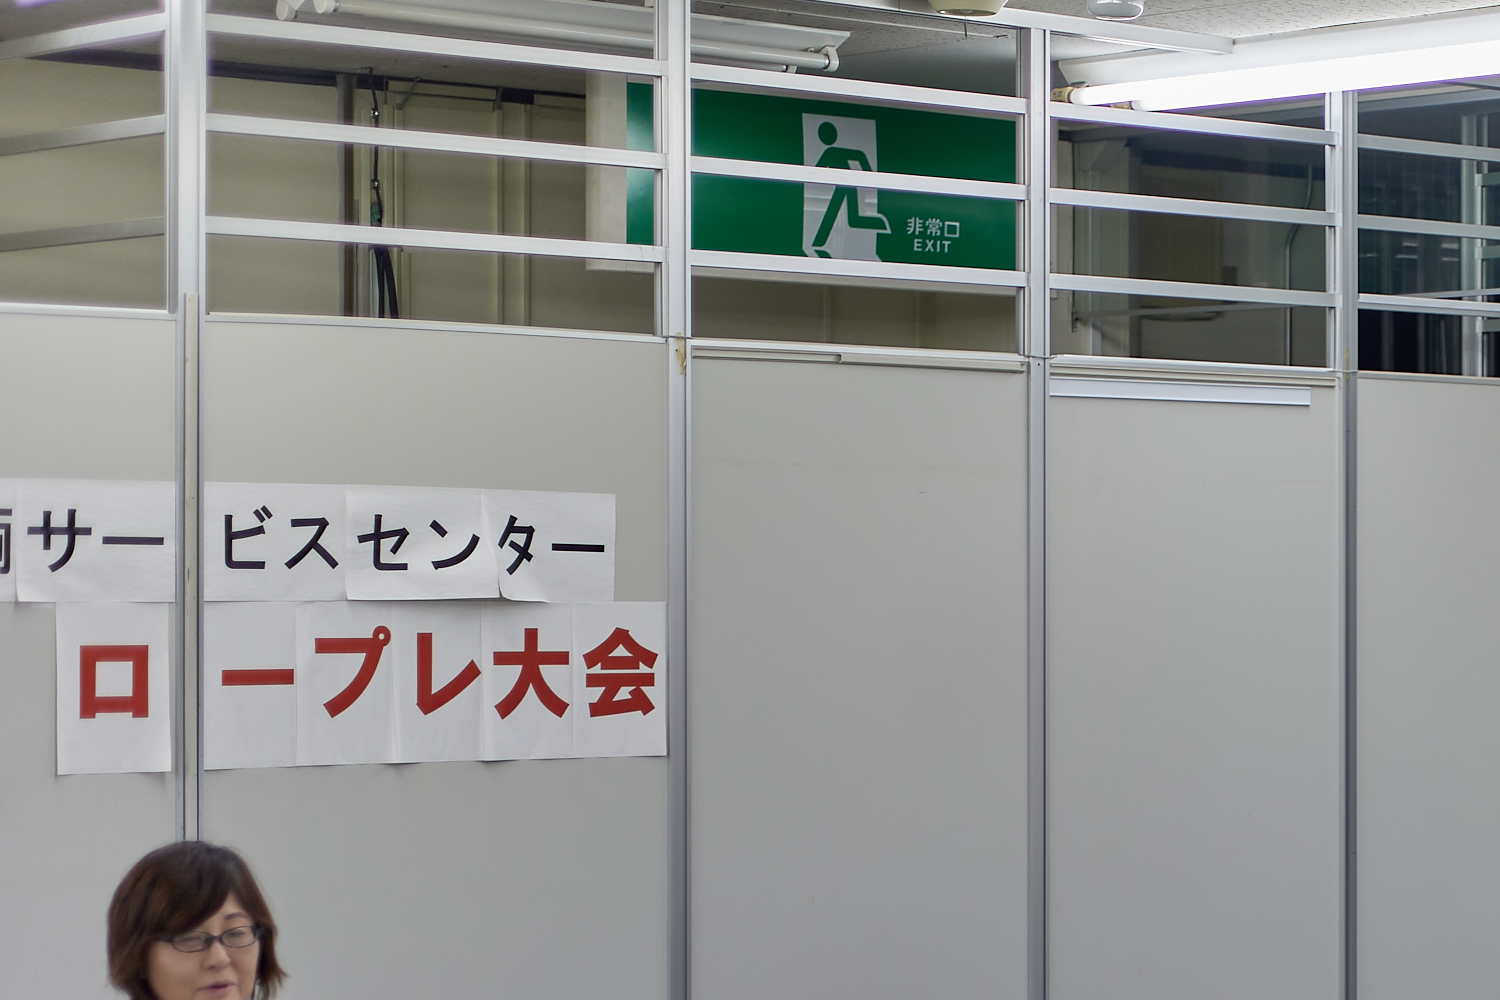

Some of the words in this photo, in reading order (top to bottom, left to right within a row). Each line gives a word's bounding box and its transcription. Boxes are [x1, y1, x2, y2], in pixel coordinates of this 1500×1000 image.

[907, 217, 960, 238] 非常口
[914, 239, 951, 253] EXIT
[0, 506, 605, 575] サービスセンター
[80, 625, 658, 720] ロープレ大会
